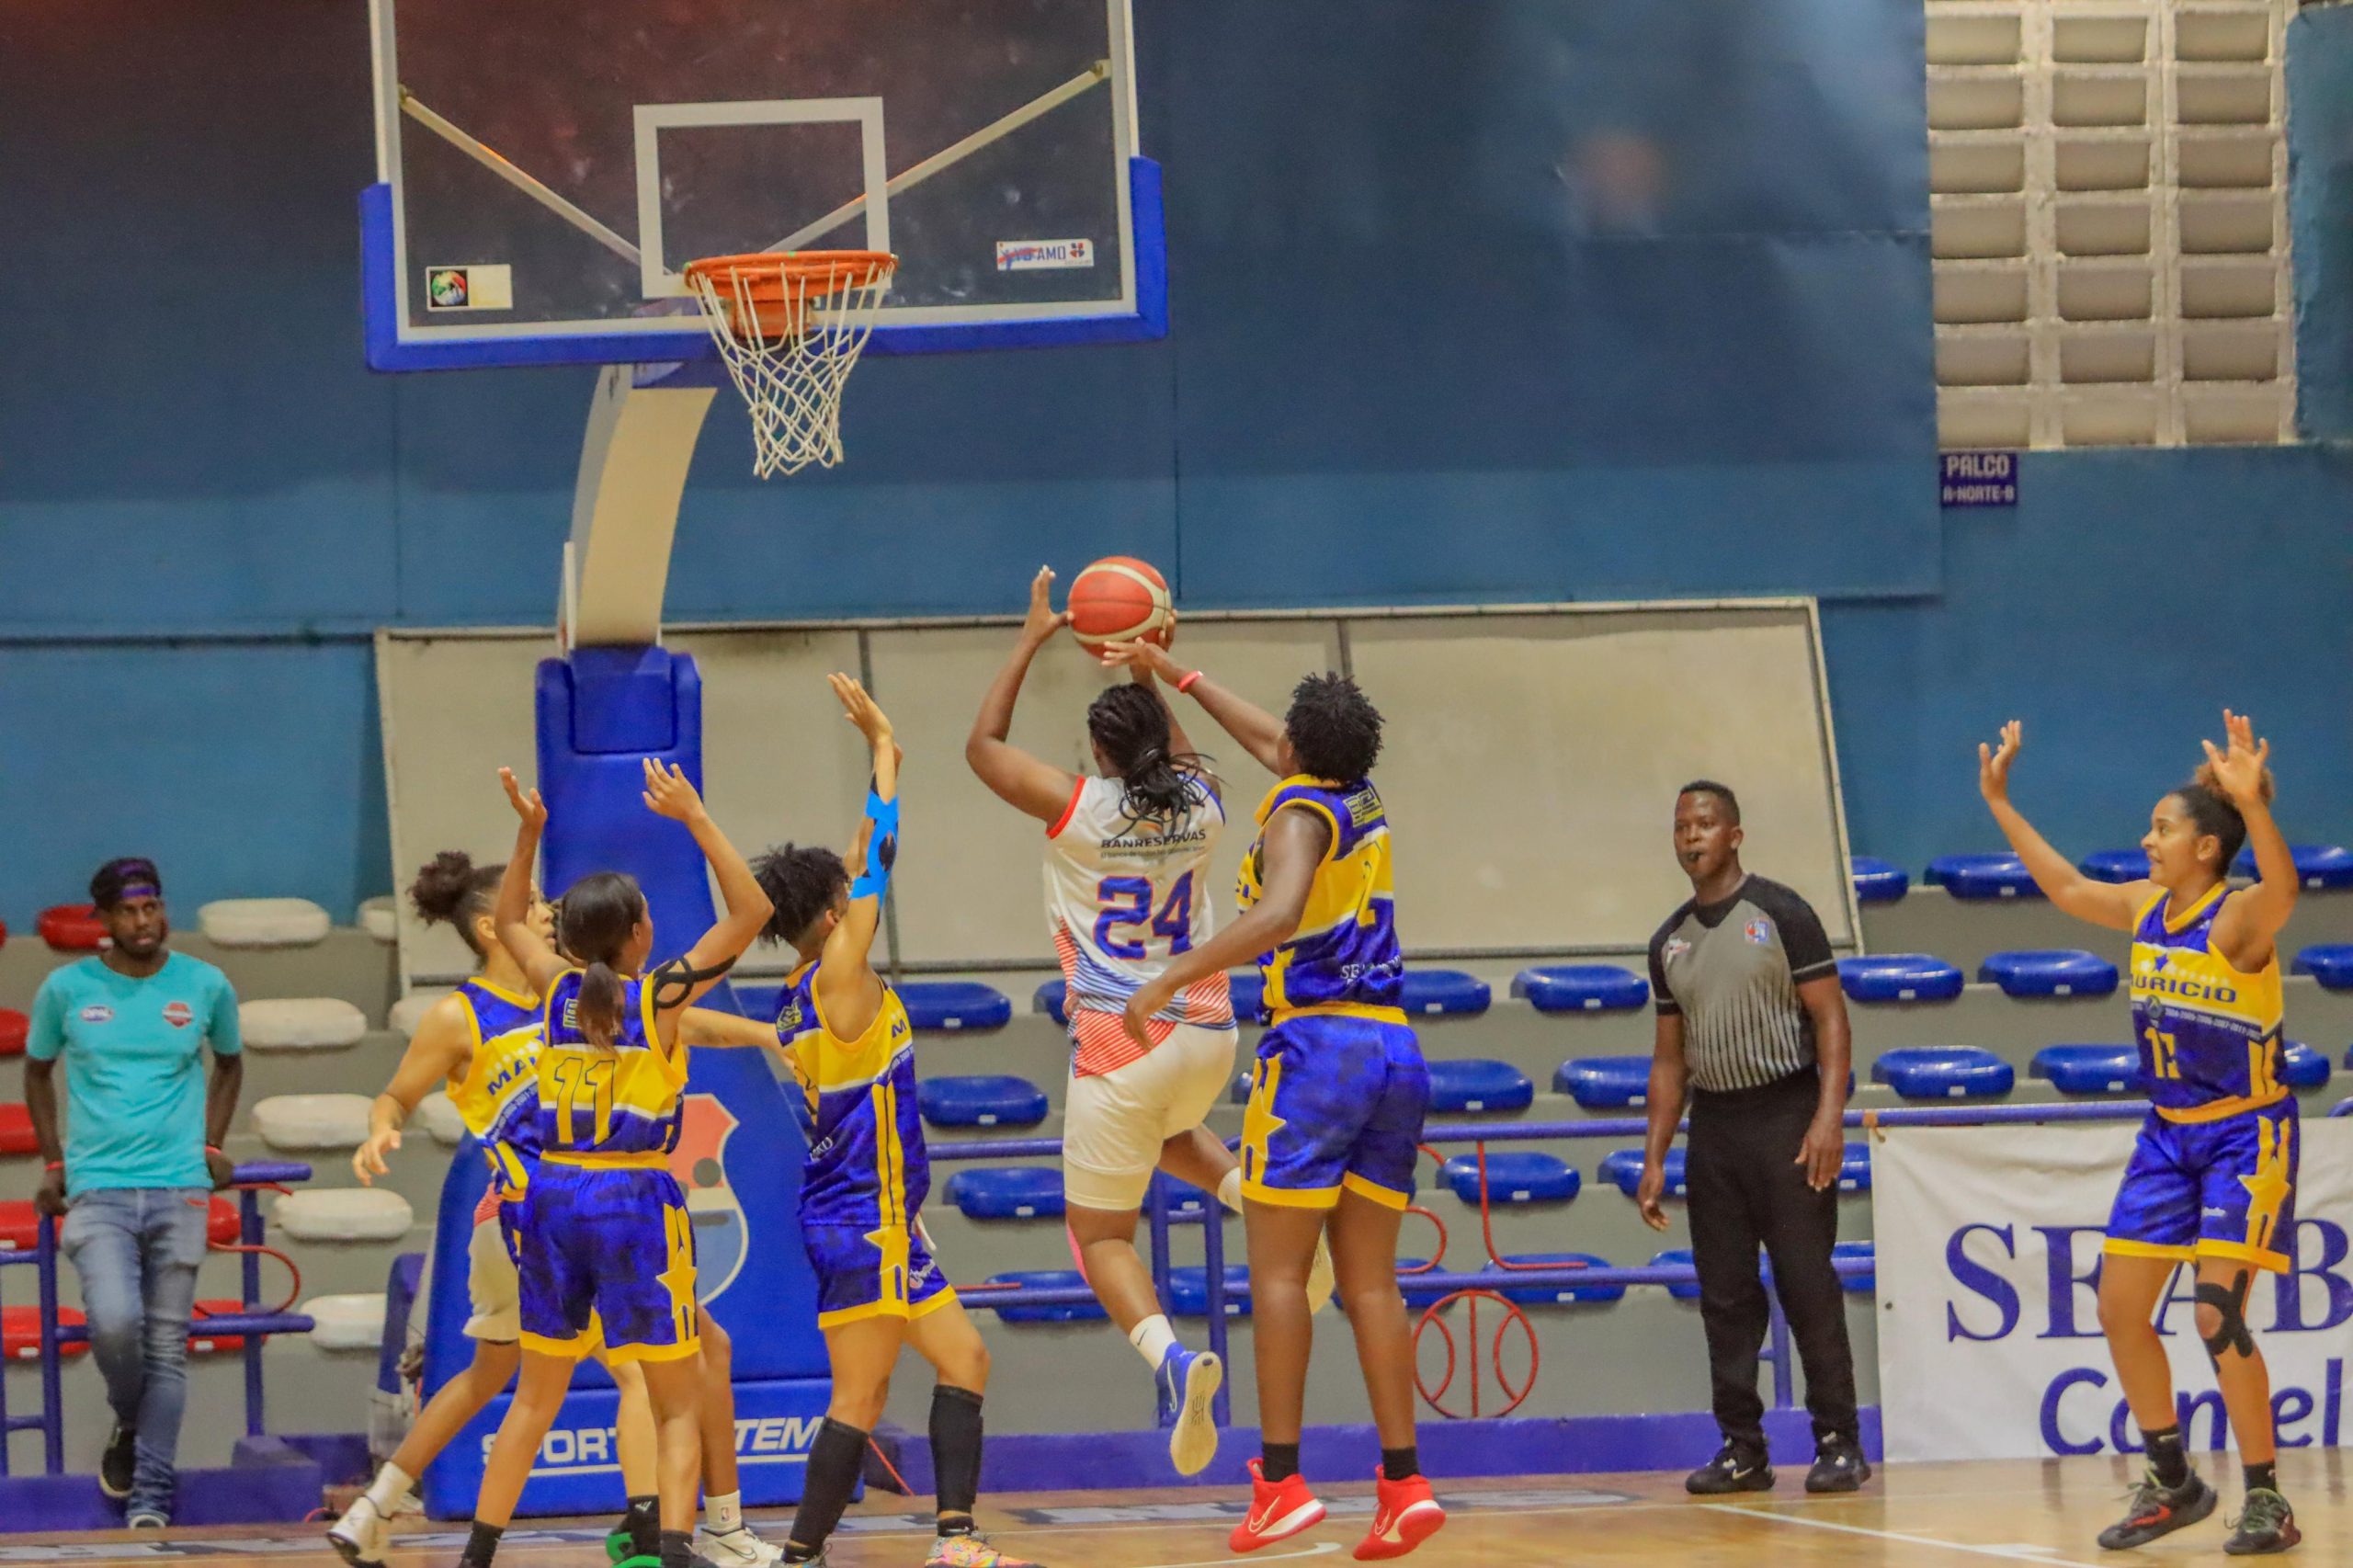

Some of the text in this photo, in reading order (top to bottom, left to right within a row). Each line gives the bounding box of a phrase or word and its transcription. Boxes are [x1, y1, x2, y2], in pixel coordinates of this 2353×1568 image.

[1946, 454, 2010, 478] PALCO
[1101, 829, 1206, 848] BANRESERVAS
[1093, 869, 1195, 960] 24
[2131, 972, 2236, 1004] URICIO
[554, 1058, 615, 1145] 11
